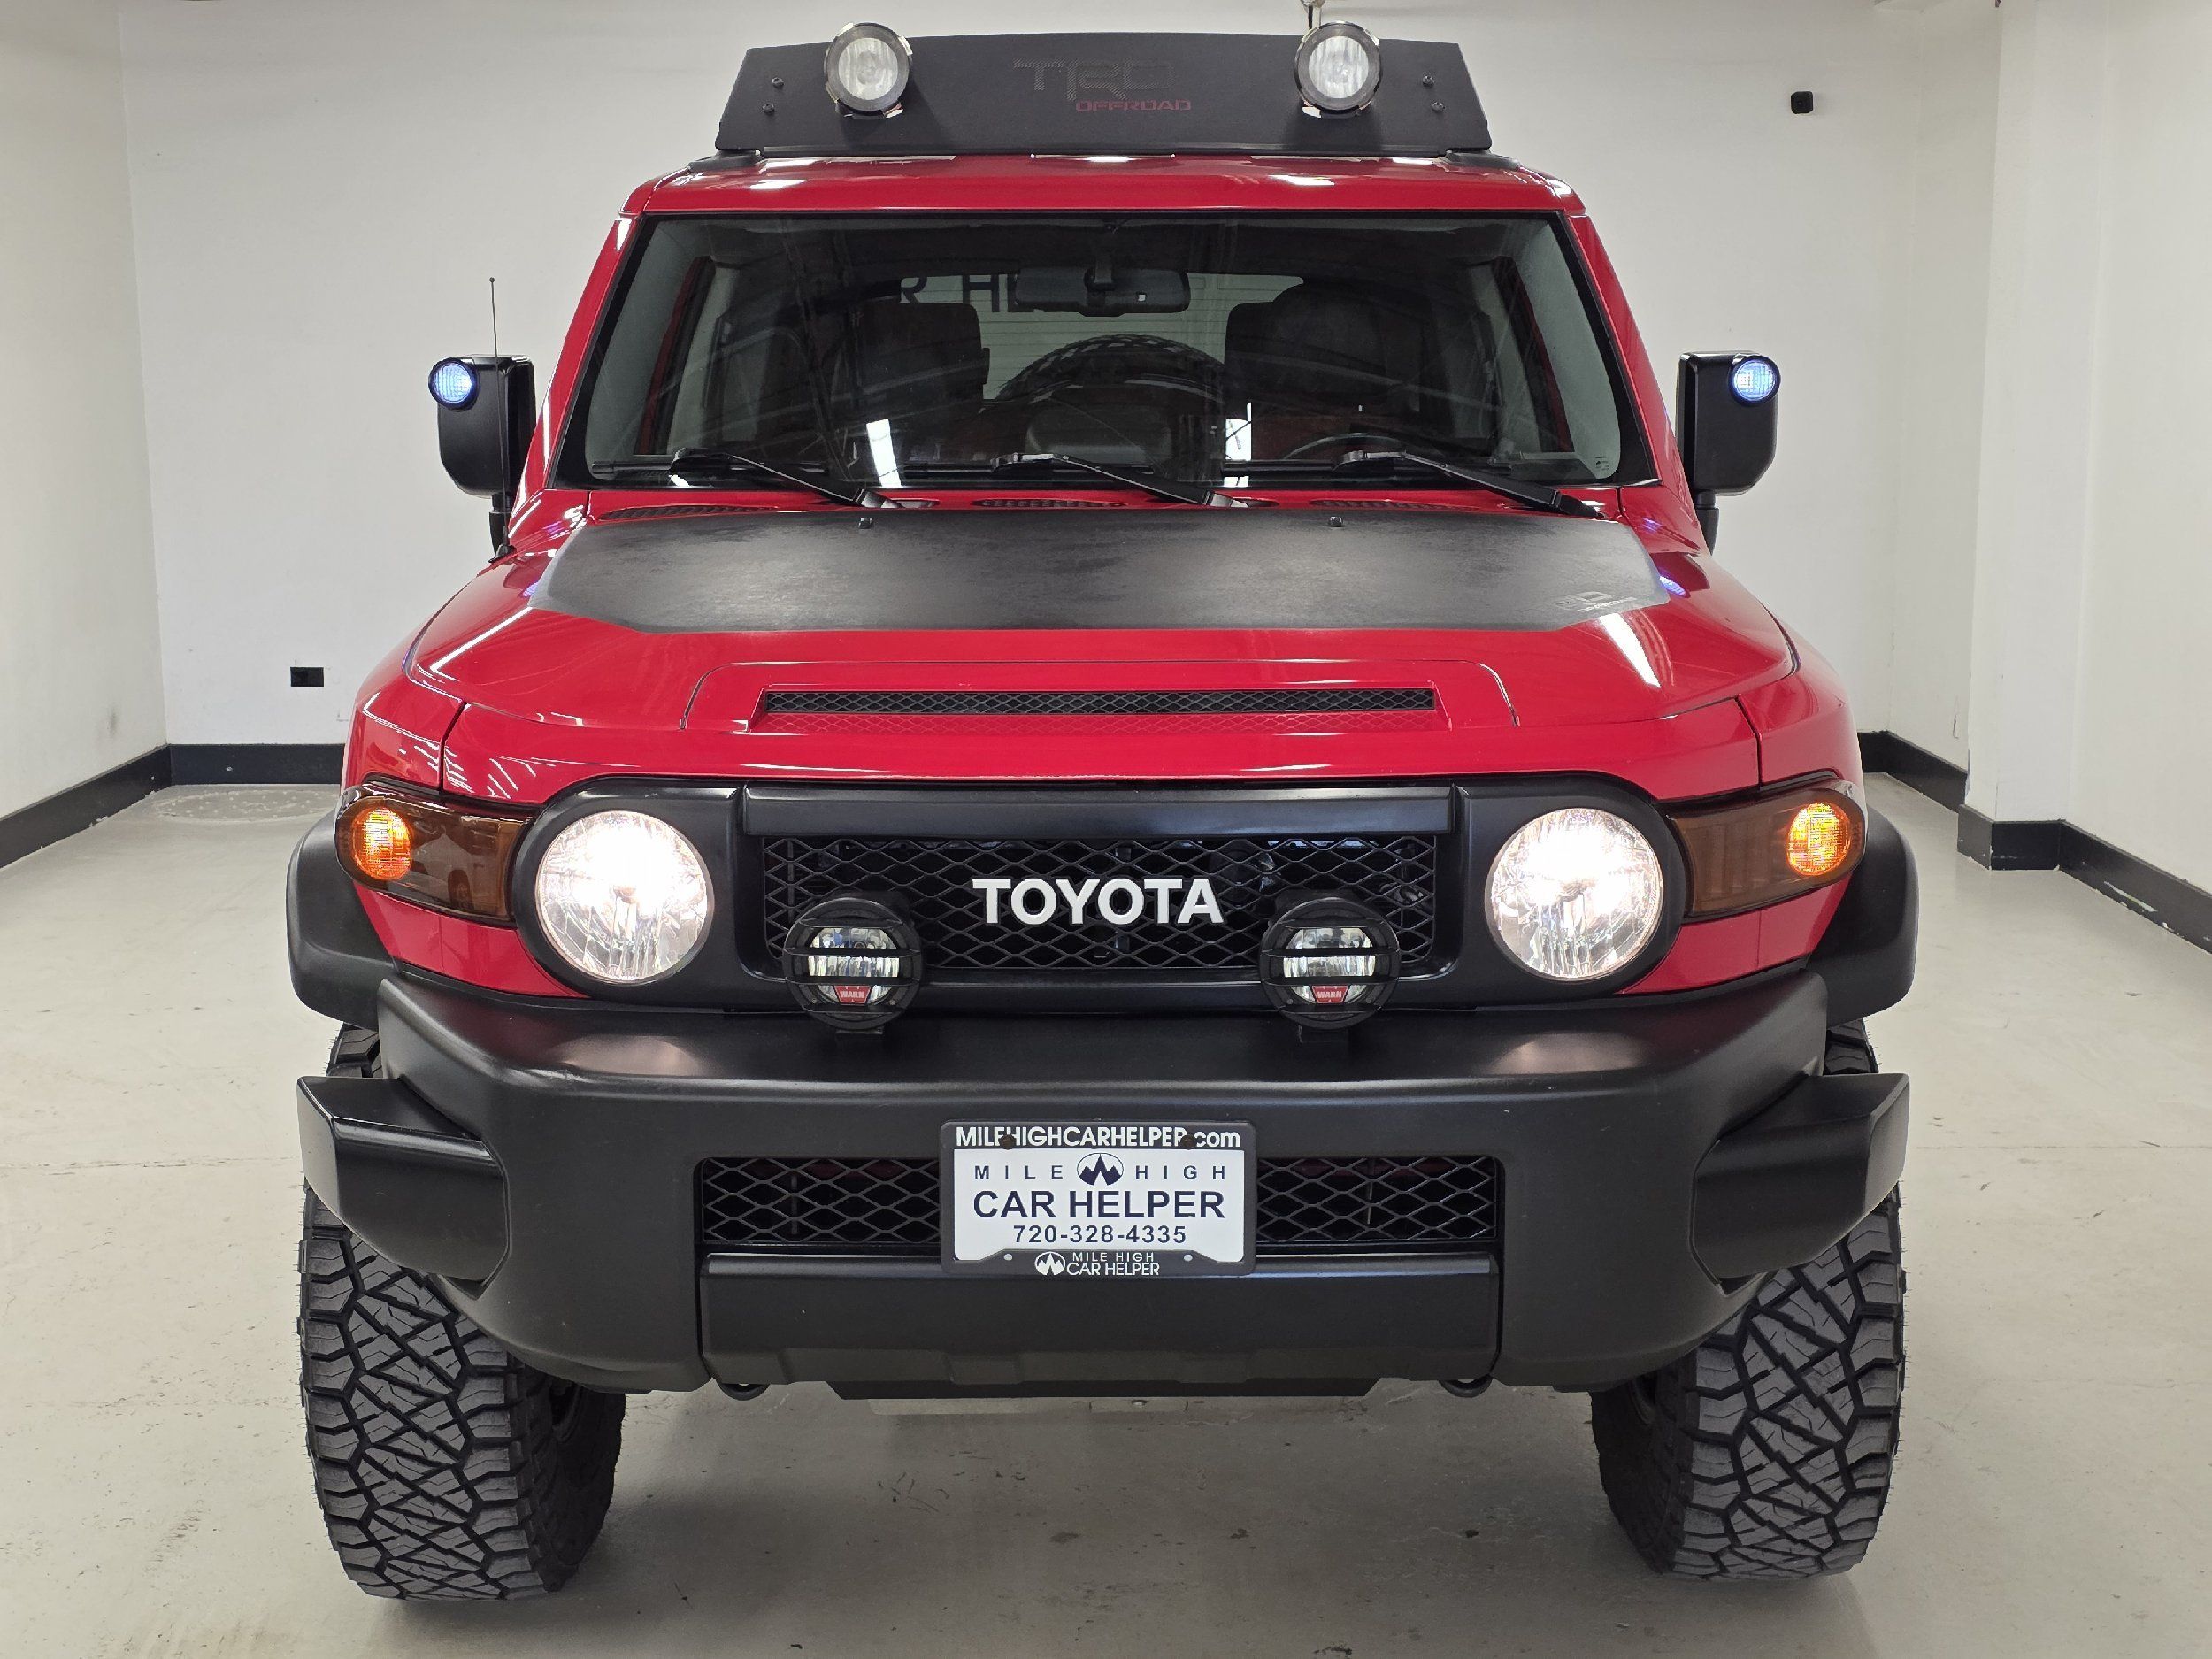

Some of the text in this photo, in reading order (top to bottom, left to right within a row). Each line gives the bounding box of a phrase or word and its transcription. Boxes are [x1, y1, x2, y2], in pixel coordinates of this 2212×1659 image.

[1012, 58, 1174, 101] TRD
[1075, 99, 1192, 112] OFFROAD
[972, 878, 1225, 925] TOYOTA
[839, 990, 865, 999] WARN
[1317, 990, 1342, 999] WARN
[956, 1126, 1240, 1148] MILEHIGHCARHELPERcom
[974, 1165, 1225, 1180] MILE HIGH
[973, 1190, 1225, 1218] CAR HELPER
[1013, 1225, 1187, 1243] 720-328-4335
[1072, 1252, 1154, 1262] MILE HIGH
[1066, 1263, 1160, 1276] CAR HELPER
